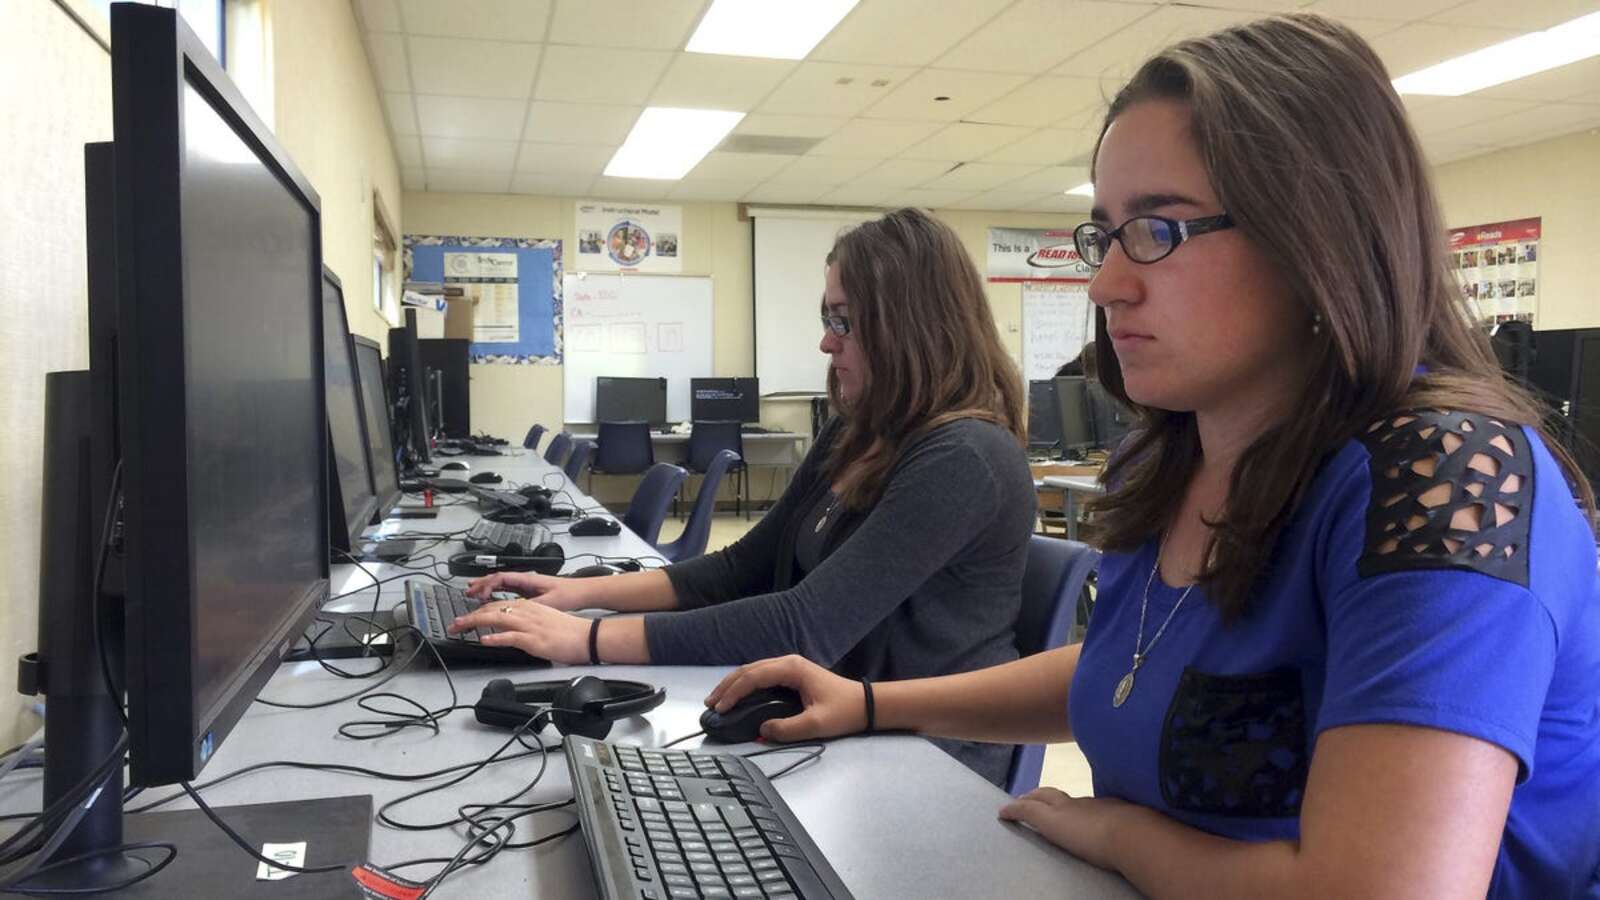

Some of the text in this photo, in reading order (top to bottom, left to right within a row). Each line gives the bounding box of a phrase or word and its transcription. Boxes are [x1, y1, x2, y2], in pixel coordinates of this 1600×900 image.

[992, 243, 1011, 253] This
[1024, 245, 1030, 253] a
[1037, 248, 1066, 259] READ
[1075, 264, 1090, 274] Cla
